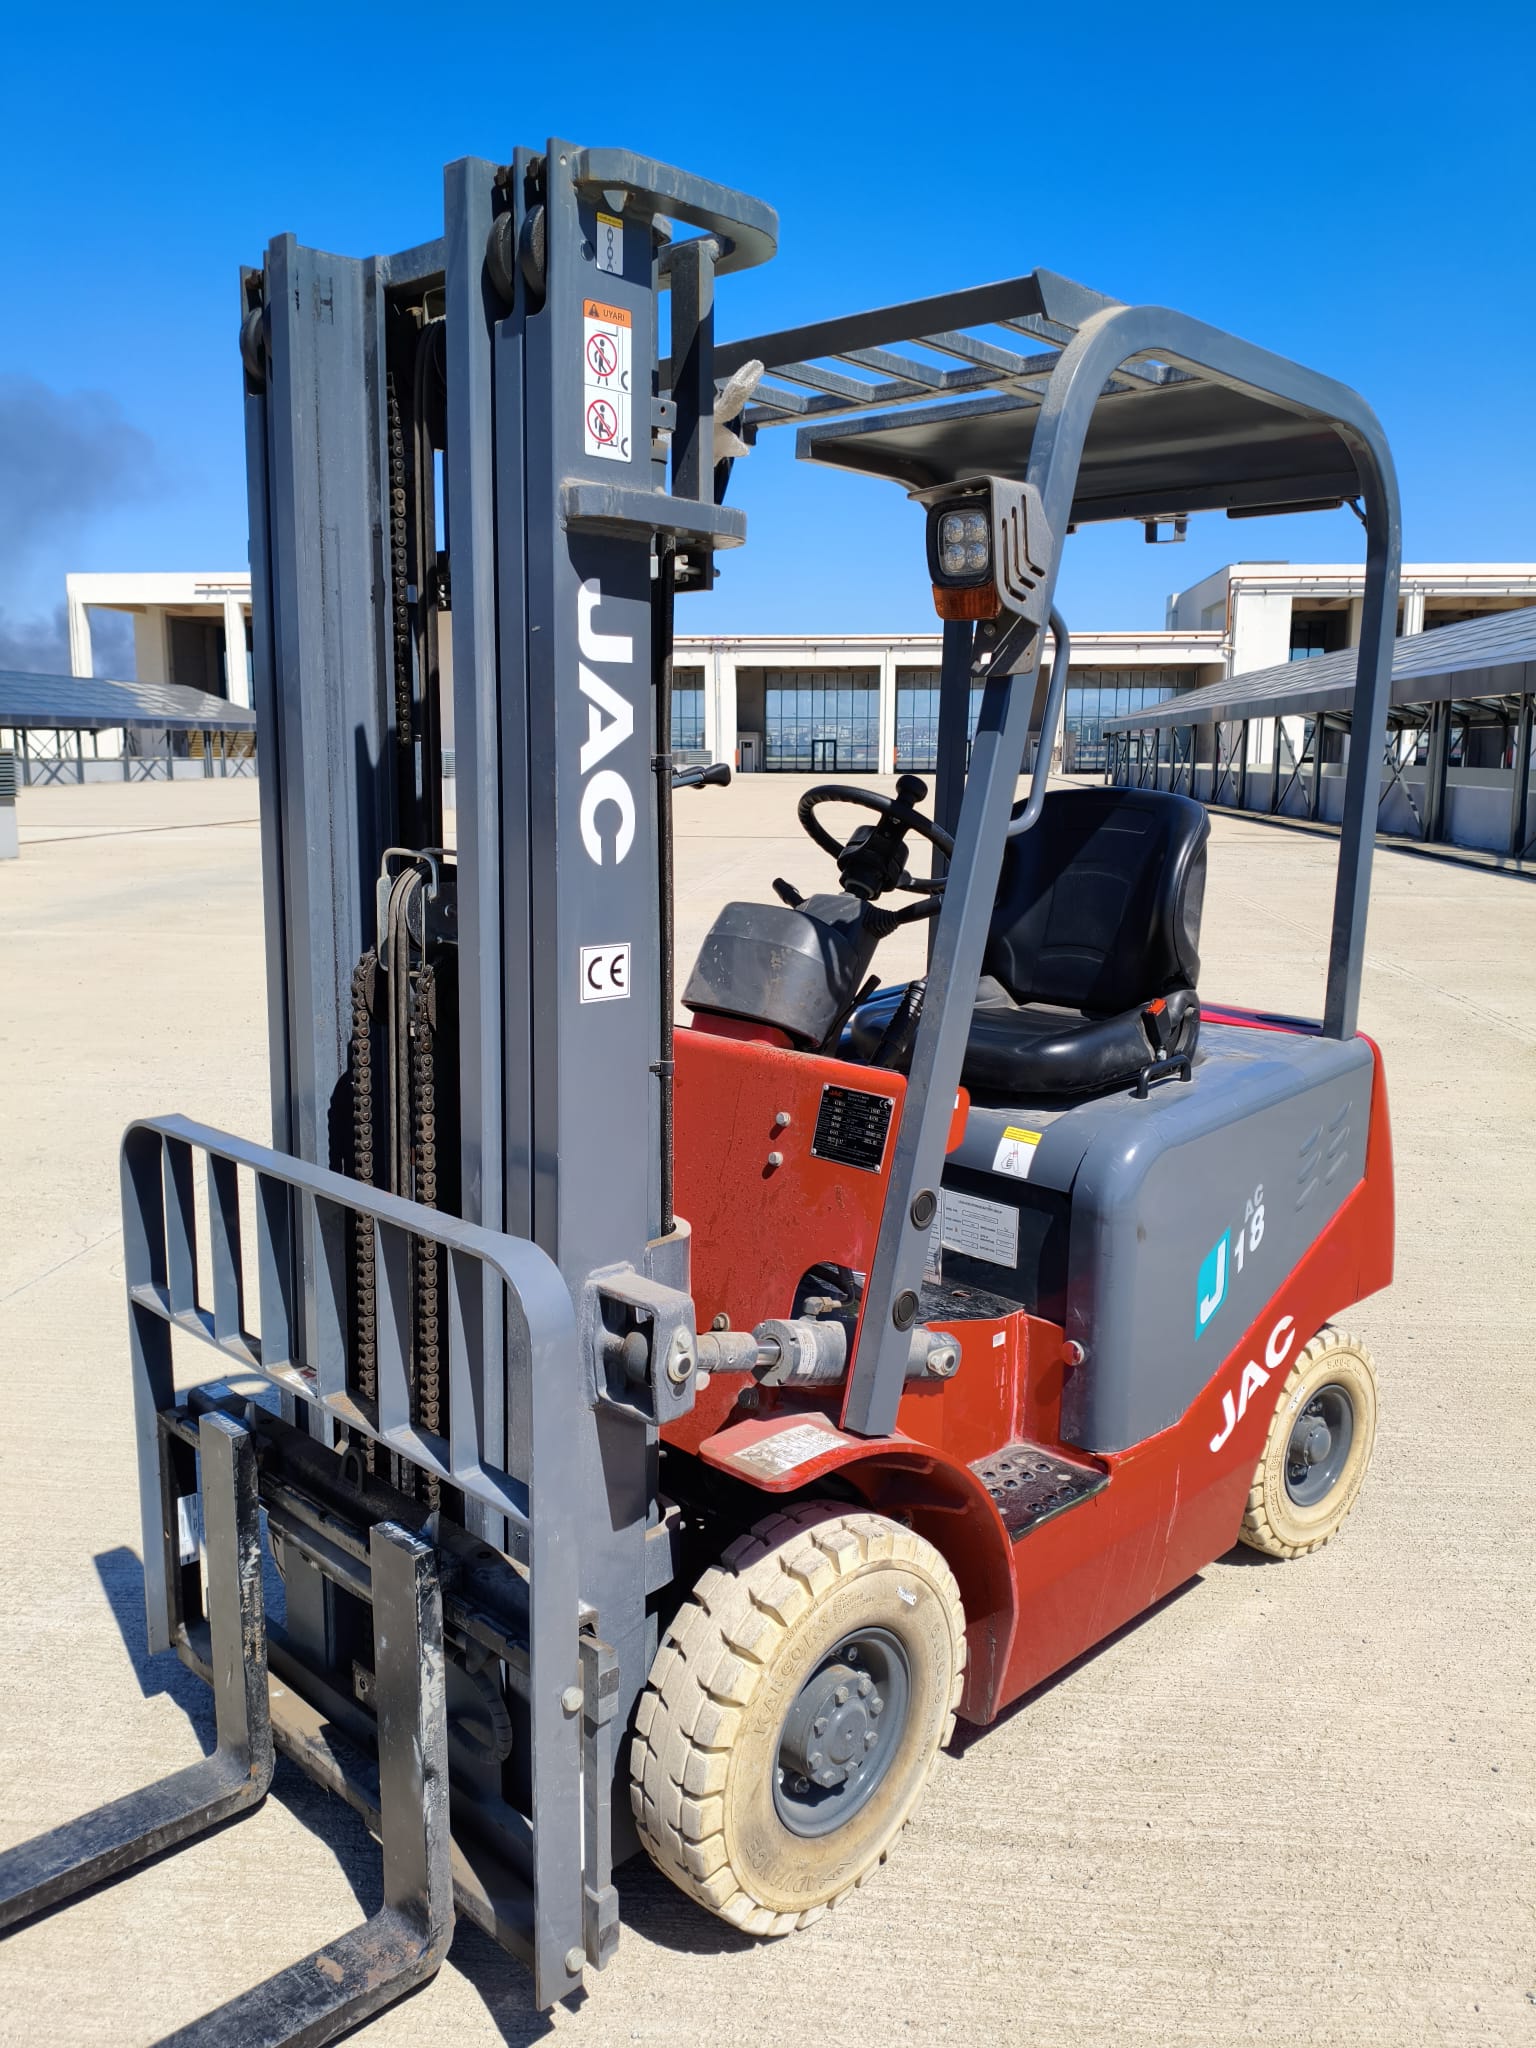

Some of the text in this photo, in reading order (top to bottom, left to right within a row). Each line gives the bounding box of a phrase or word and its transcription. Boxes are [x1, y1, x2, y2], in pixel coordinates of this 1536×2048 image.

[603, 309, 625, 321] UYARI
[578, 578, 636, 866] JAC
[587, 953, 625, 990] CE
[1244, 1183, 1264, 1222] AC
[1209, 1314, 1296, 1453] JAC
